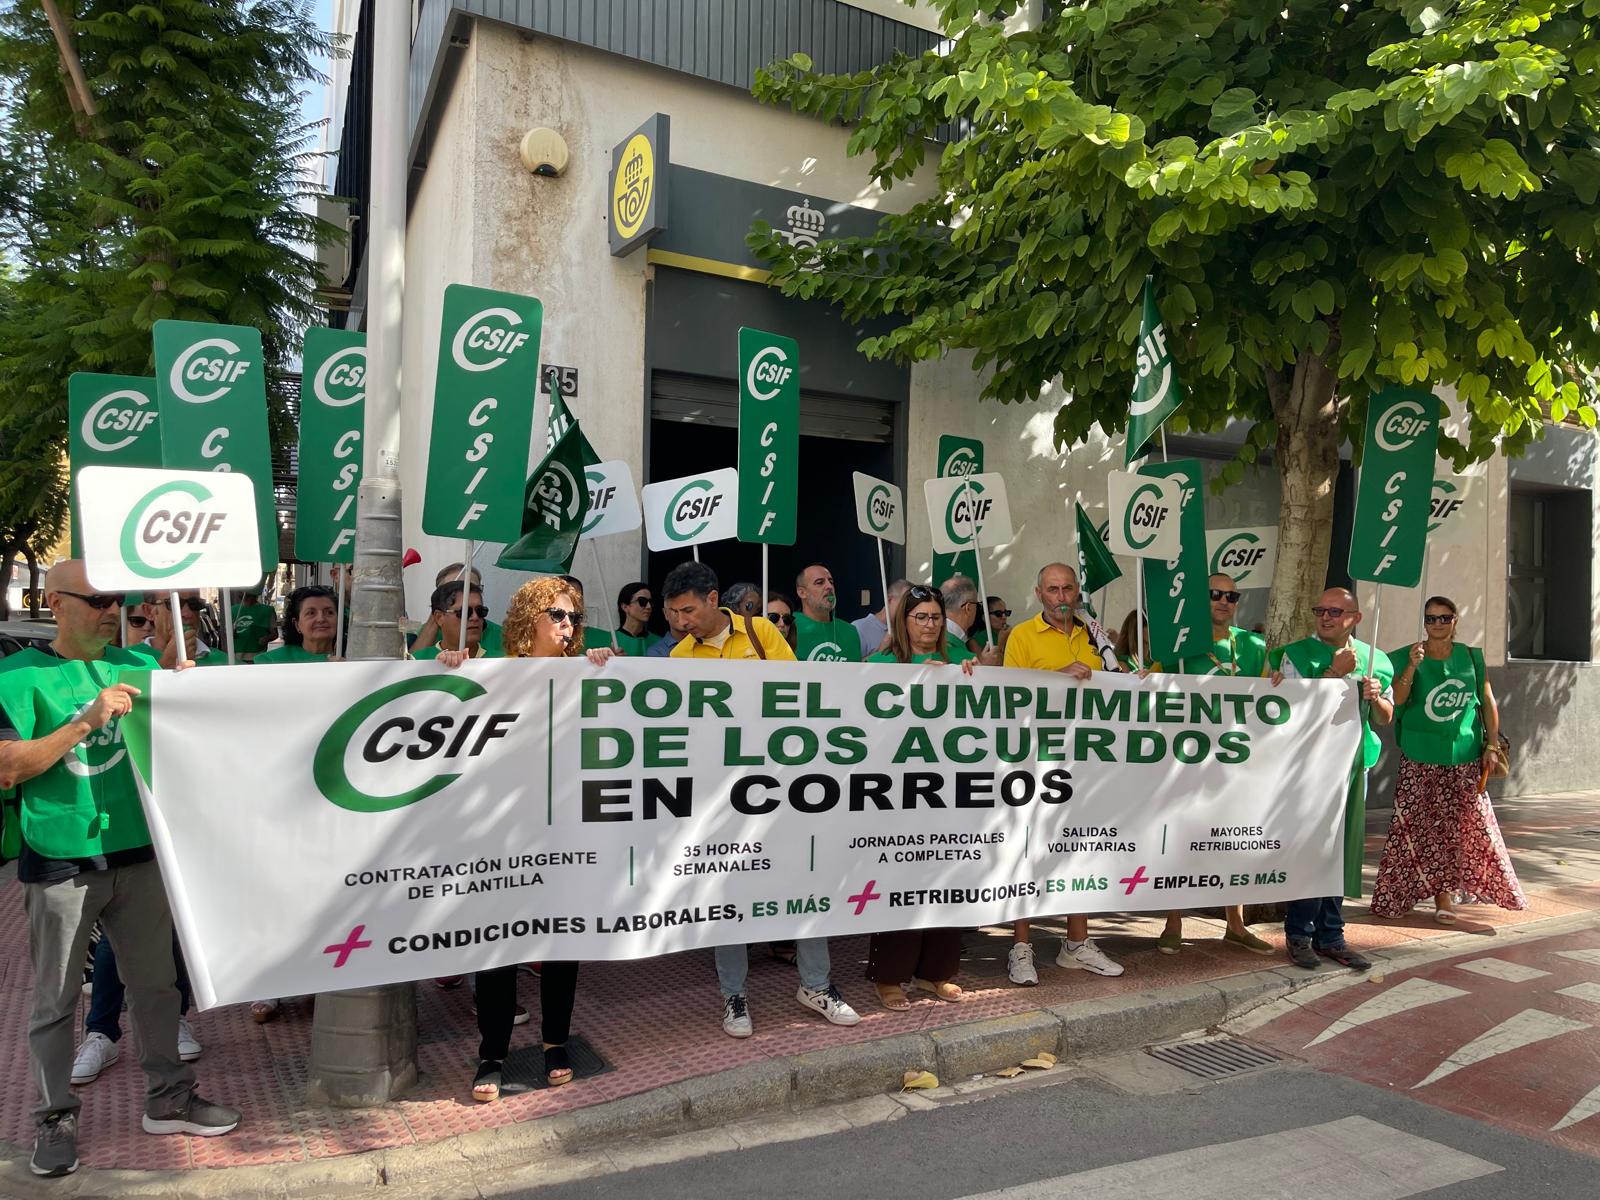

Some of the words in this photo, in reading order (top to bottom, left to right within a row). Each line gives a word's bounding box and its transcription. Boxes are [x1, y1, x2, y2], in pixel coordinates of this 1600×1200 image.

[468, 325, 530, 356] CSIF
[186, 356, 250, 383] CSIF
[754, 360, 793, 385] CSIF
[97, 406, 159, 431] CSIF
[1385, 415, 1431, 437] CSIF
[456, 397, 498, 530] CSIF
[328, 430, 361, 555] CSIF
[757, 422, 778, 537] CSIF
[540, 471, 563, 532] CSIF
[587, 486, 616, 512] SIF
[675, 492, 724, 523] CSIF
[872, 498, 895, 520] CSIF
[1430, 498, 1464, 518] SIF
[142, 510, 227, 545] CSIF
[1132, 502, 1169, 529] CSIF
[1373, 471, 1407, 576] CSIF
[1221, 547, 1266, 569] CSIF
[581, 678, 734, 719] POR
[761, 681, 841, 718] EL
[864, 682, 1292, 726] CUMPLIMIENTO
[1433, 688, 1472, 709] CSIF
[362, 713, 520, 763] CSIF
[581, 727, 690, 770] DE
[724, 726, 868, 767] LOS
[891, 726, 1251, 764] ACUERDOS
[581, 777, 693, 823] EN
[730, 769, 1074, 815] CORREOS
[849, 833, 925, 849] JORNADAS
[929, 832, 1006, 846] PARCIALES
[1062, 826, 1118, 838] SALIDAS
[1210, 826, 1263, 837] MAYORES
[683, 845, 702, 858] 35
[706, 841, 763, 857] HORAS
[878, 853, 889, 863] A
[894, 849, 982, 863] COMPLETAS
[1048, 841, 1137, 853] VOLUNTARIAS
[1190, 839, 1281, 852] RETRIBUCIONES
[344, 857, 502, 888] CONTRATACIÓN
[508, 850, 598, 870] URGENTE
[673, 858, 772, 877] SEMANALES
[1153, 874, 1225, 890] EMPLEO,
[1229, 873, 1250, 887] ES
[1254, 870, 1288, 885] MÁS
[408, 884, 435, 900] DE
[441, 872, 545, 897] PLANTILLA
[889, 881, 1041, 908] RETRIBUCIONES,
[1045, 879, 1067, 893] ES
[1071, 874, 1109, 892] MÁS
[387, 916, 586, 955] CONDICIONES
[596, 903, 745, 934] LABORALES,
[752, 901, 778, 918] ES
[786, 894, 831, 915] MÁS
